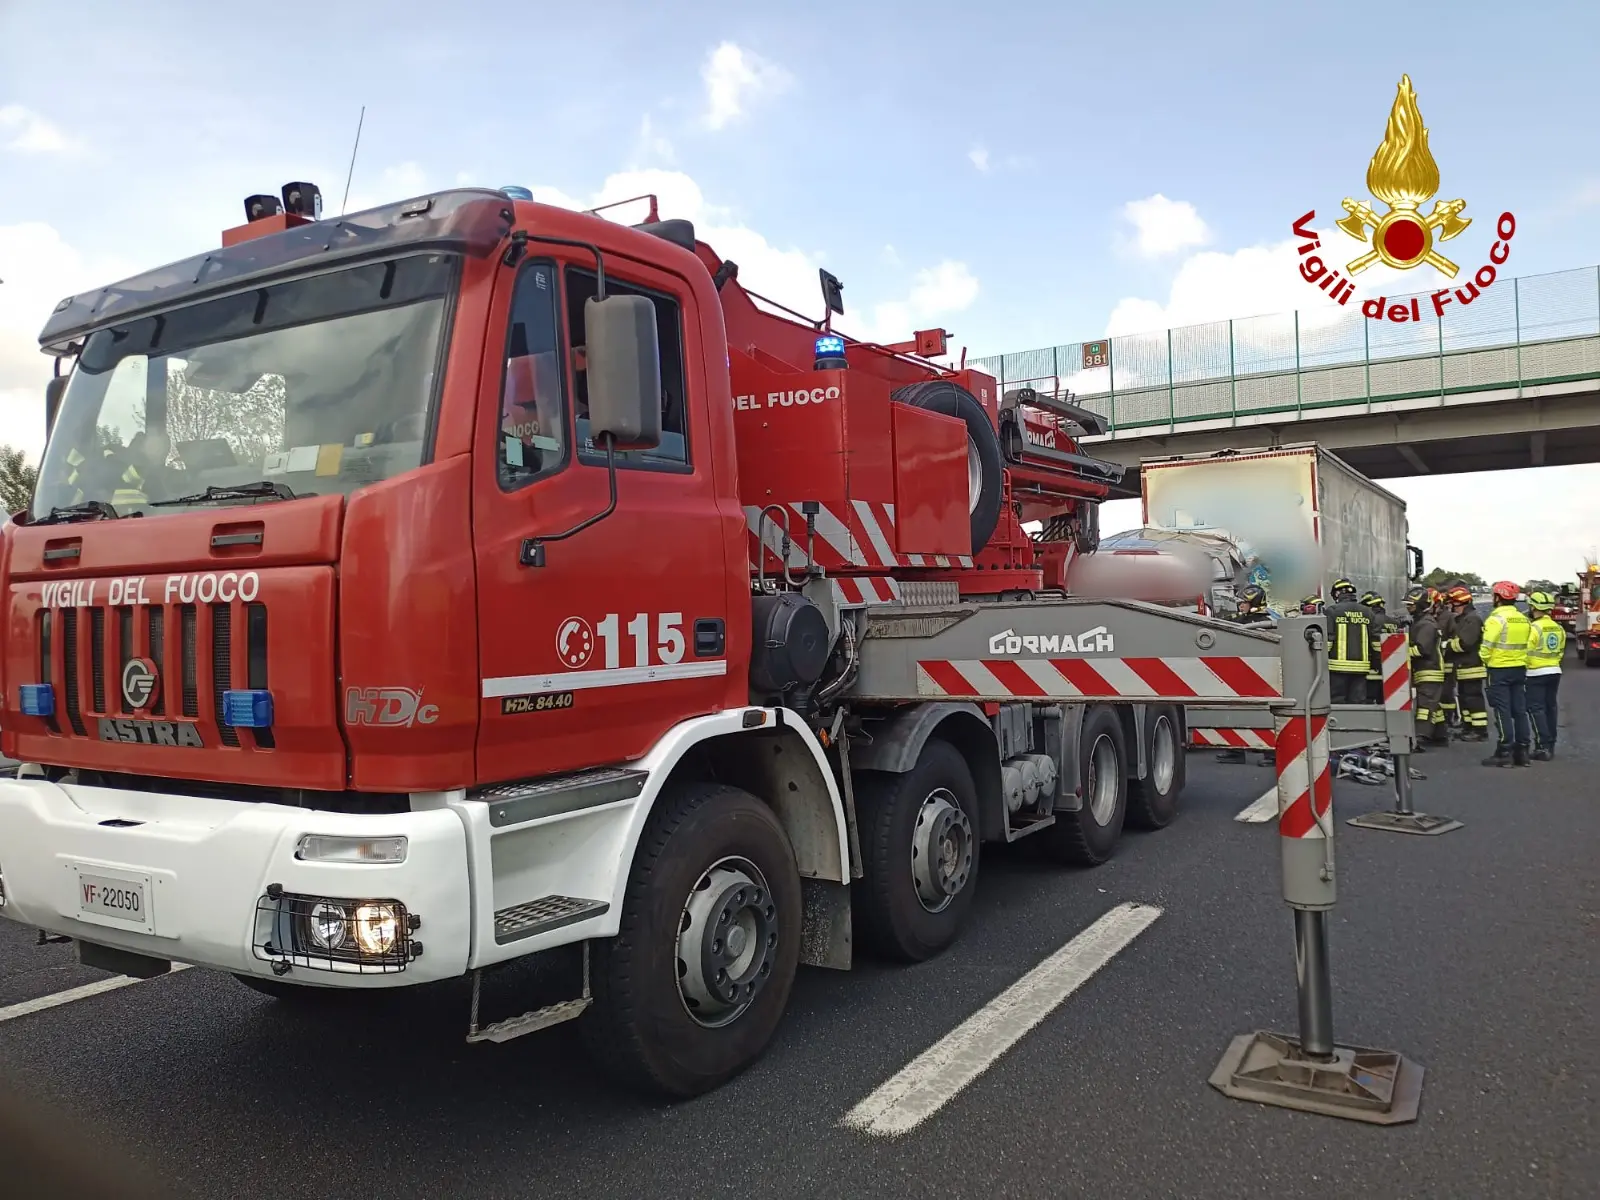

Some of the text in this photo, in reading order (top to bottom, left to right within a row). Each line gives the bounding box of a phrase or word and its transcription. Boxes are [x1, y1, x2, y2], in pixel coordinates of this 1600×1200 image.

[1085, 354, 1106, 366] 381
[767, 386, 840, 408] FUOCO
[41, 571, 259, 608] VIGILI DEL FUOCO
[1336, 616, 1349, 624] DEL
[597, 612, 686, 669] 115
[989, 626, 1114, 654] CORMACH
[535, 693, 573, 710] 84.40
[98, 718, 204, 747] ASTRA
[83, 884, 140, 912] VF 22050
